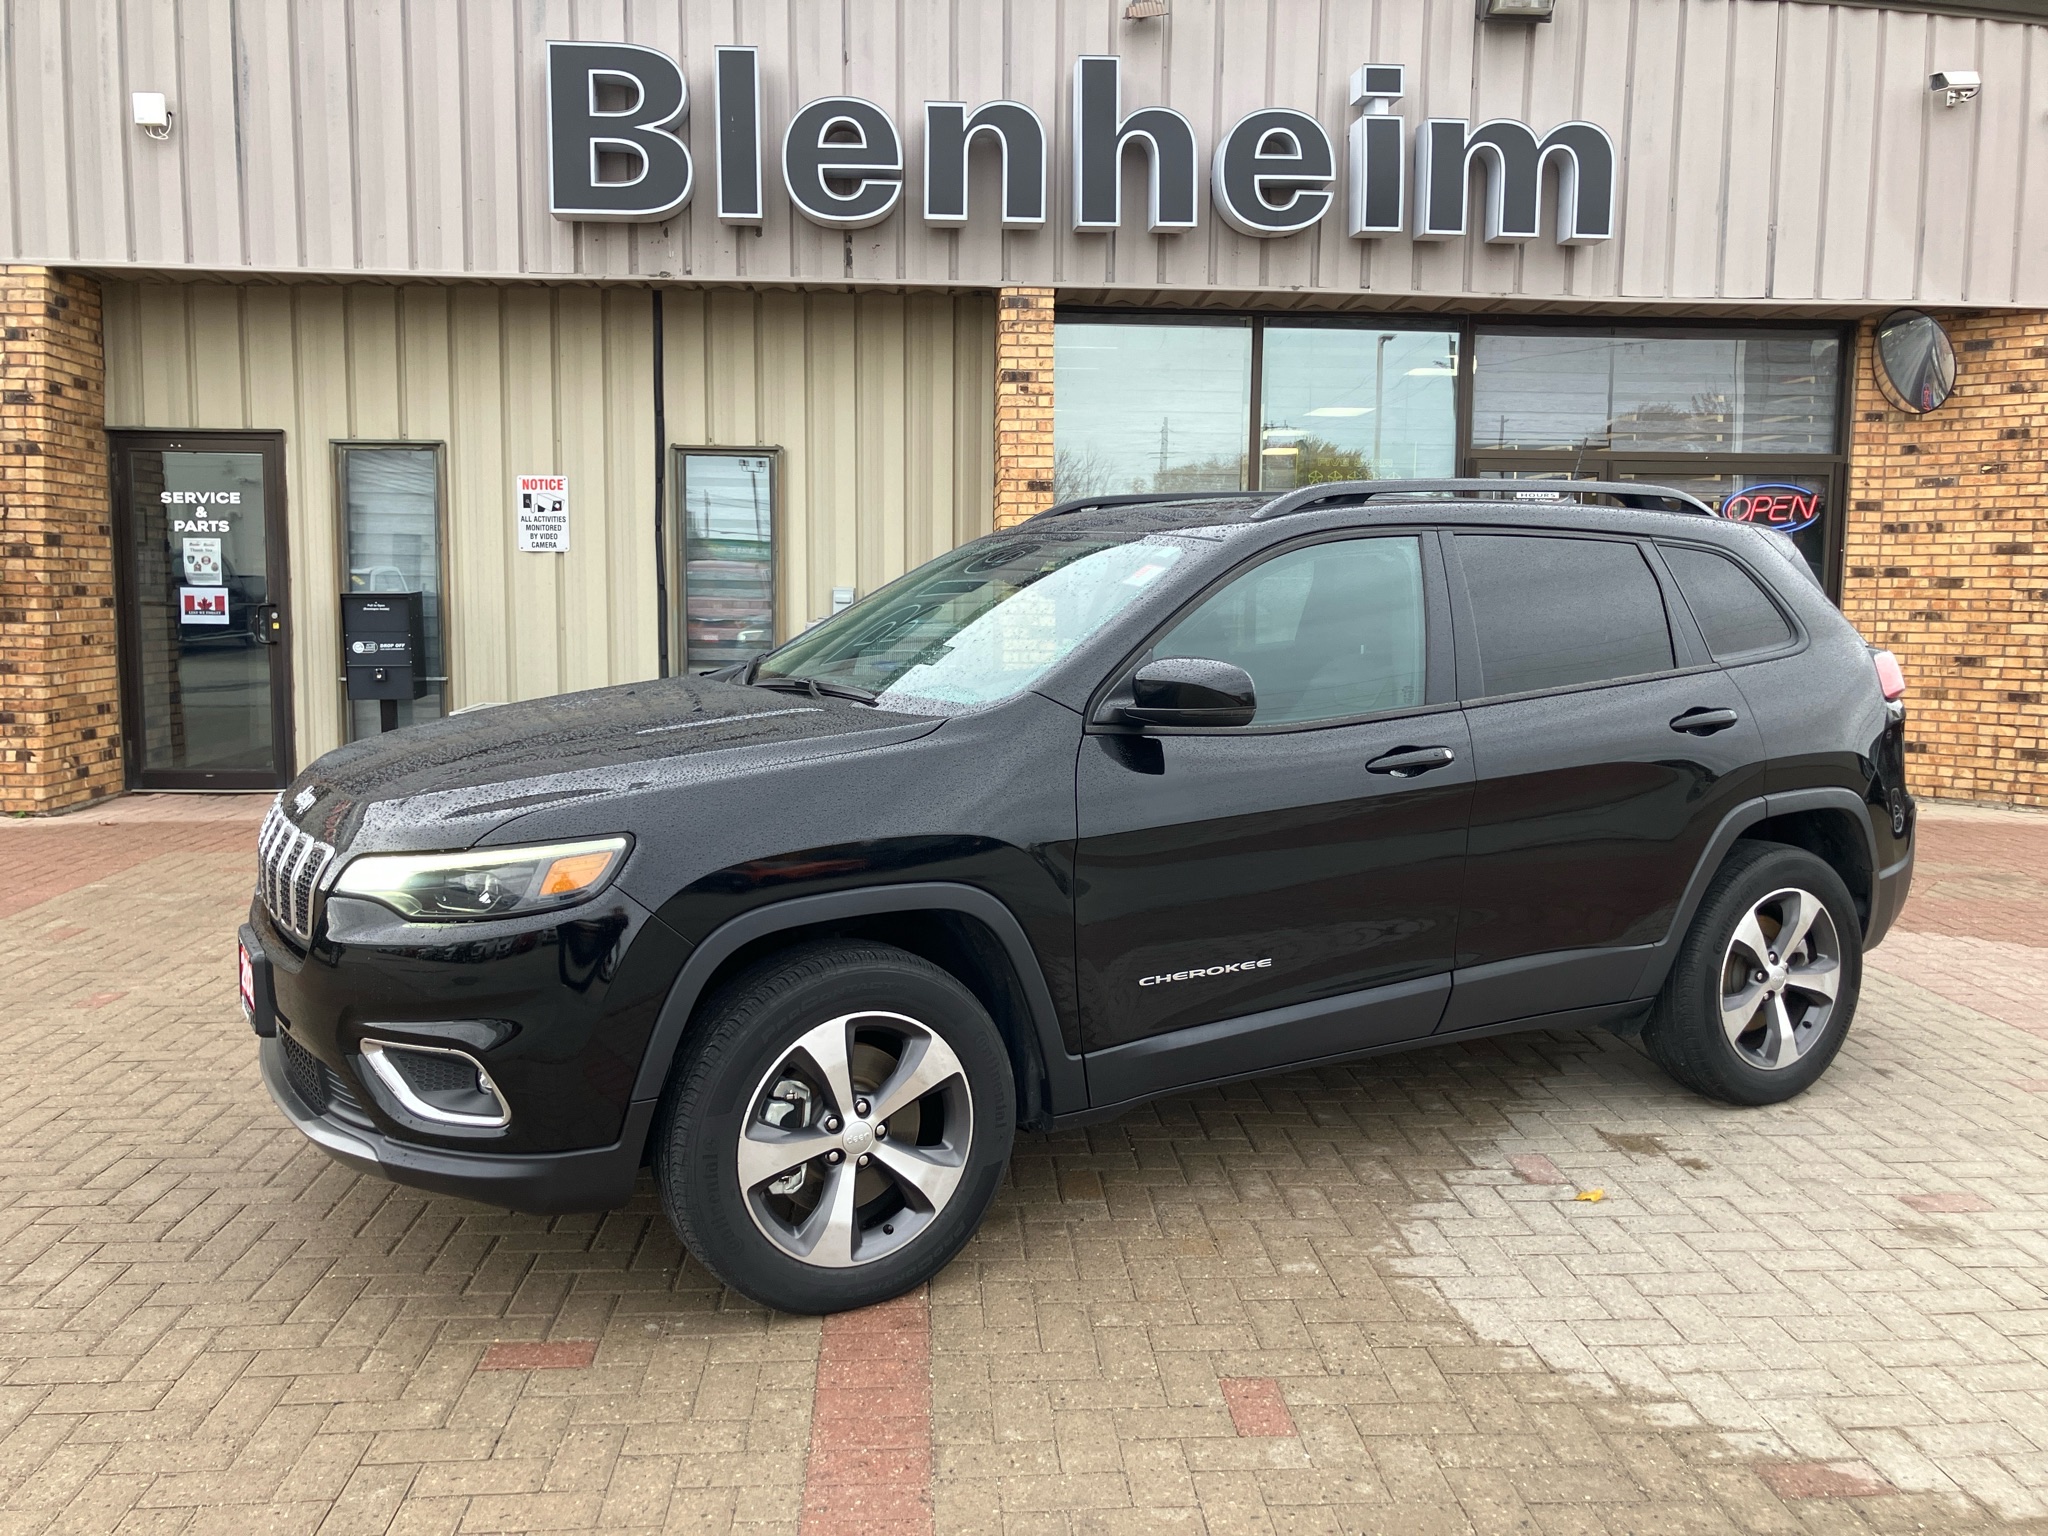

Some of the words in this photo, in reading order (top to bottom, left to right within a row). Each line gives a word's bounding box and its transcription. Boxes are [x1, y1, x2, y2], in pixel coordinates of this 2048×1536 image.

[546, 40, 1617, 246] Blenheim
[522, 478, 564, 491] NOTICE
[160, 491, 241, 504] SERVICE
[195, 505, 208, 518] &
[1727, 494, 1818, 521] OPEN
[174, 520, 230, 532] PARTS
[1138, 958, 1272, 987] CHEROKEE
[846, 1131, 870, 1145] Jeep
